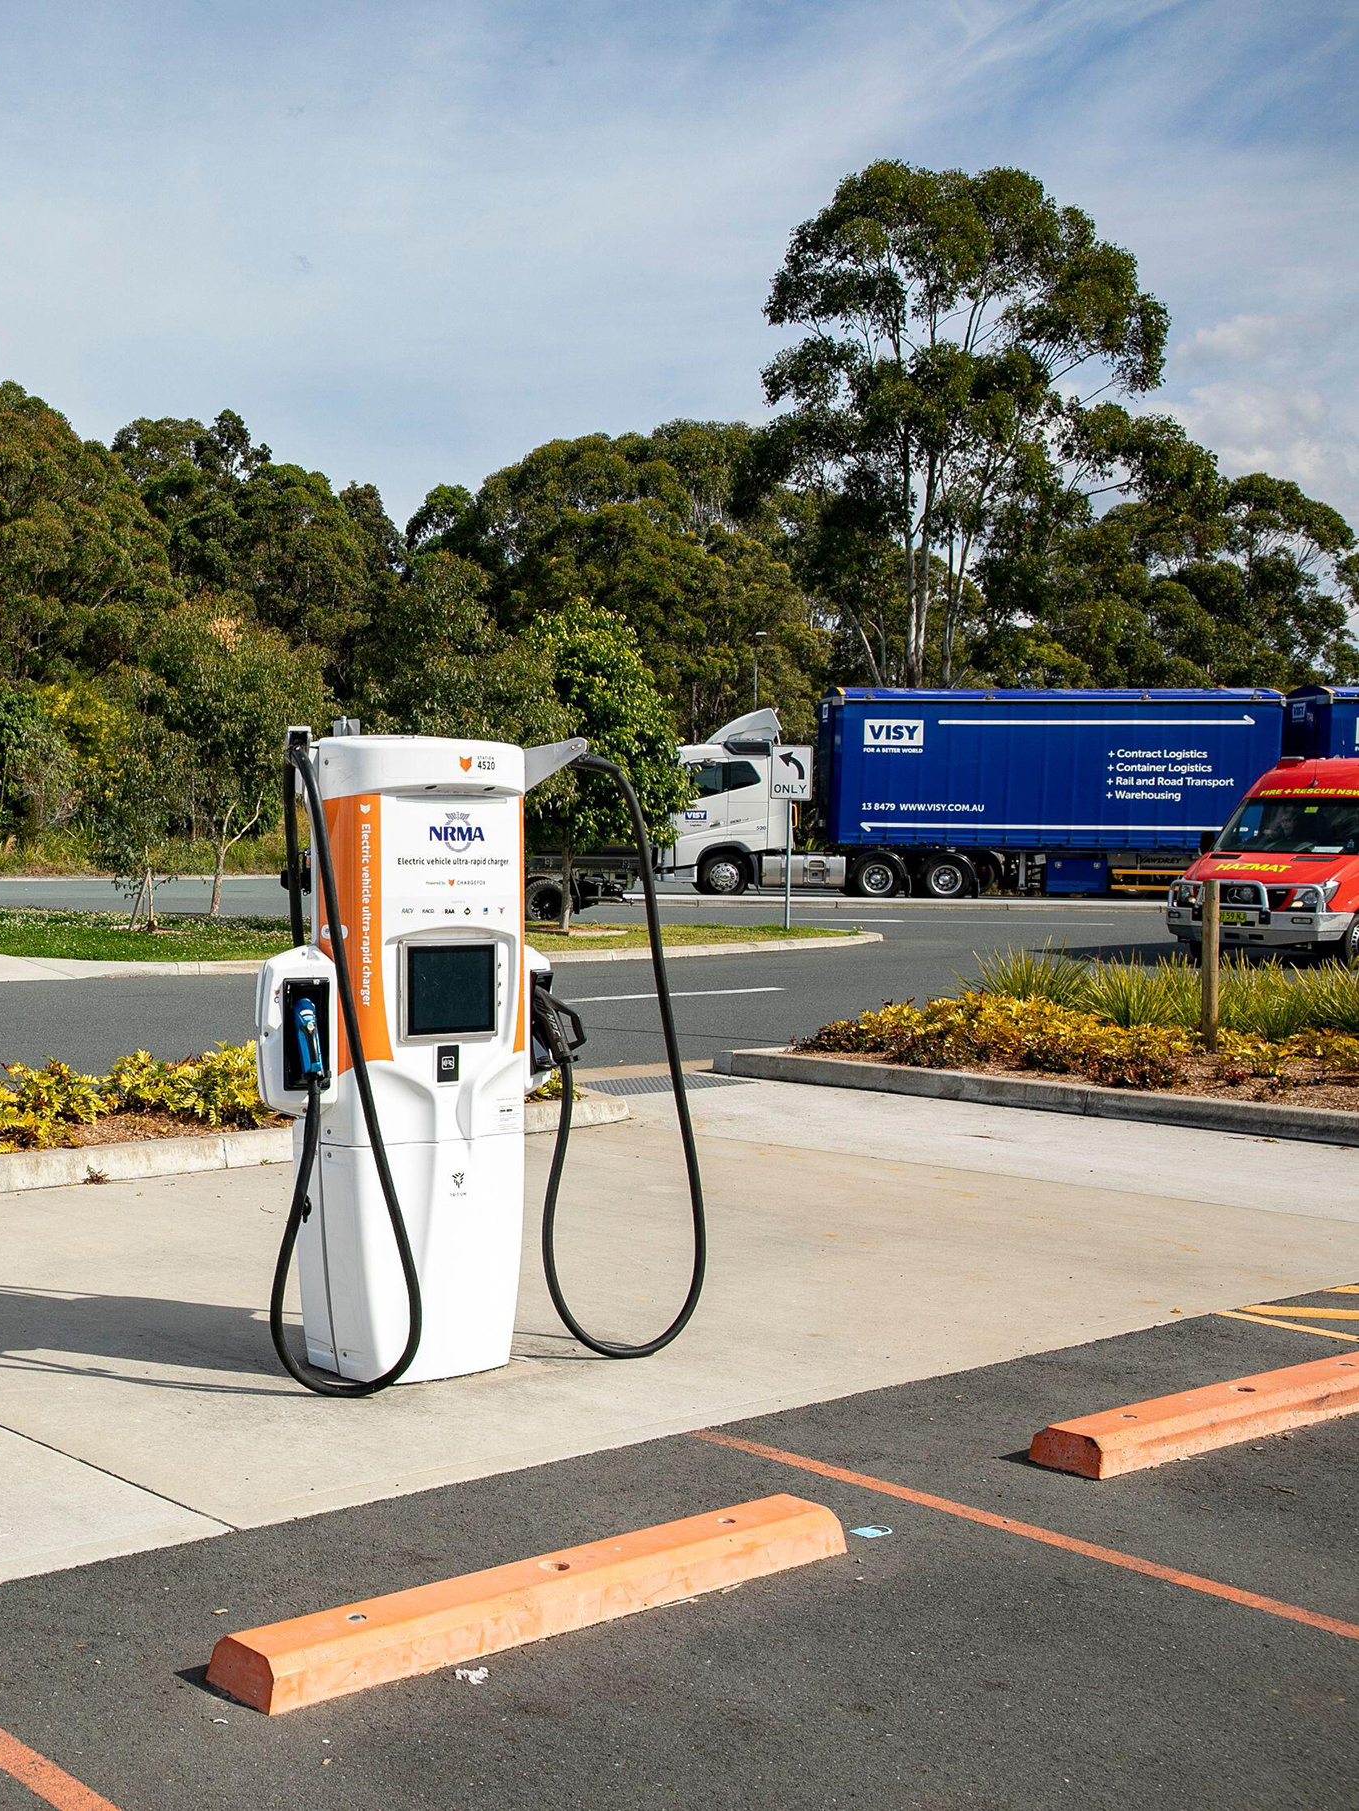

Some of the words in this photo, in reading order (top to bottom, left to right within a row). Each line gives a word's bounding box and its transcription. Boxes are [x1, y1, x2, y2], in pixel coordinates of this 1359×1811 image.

[869, 725, 919, 740] VISY
[1117, 749, 1162, 758] Contract
[1163, 750, 1208, 760] Logistics
[477, 761, 496, 770] 4520
[1116, 763, 1167, 772] Container
[1168, 763, 1213, 774] Logistics
[1115, 777, 1134, 786] Rail
[1136, 777, 1155, 786] and
[1157, 777, 1183, 786] Road
[1185, 777, 1235, 788] Transport
[774, 784, 807, 794] ONLY
[1115, 790, 1181, 801] Warehousing
[862, 803, 872, 811] 13
[874, 803, 896, 811] 8479
[899, 803, 985, 812] WWW.VISY.COM.AU
[686, 811, 706, 819] VISY
[429, 826, 485, 842] NRMA
[361, 823, 371, 864] Electric
[397, 857, 424, 866] Electric
[426, 857, 452, 866] vehicle
[453, 857, 487, 867] ultra-rapid
[488, 858, 509, 867] charger
[1215, 863, 1292, 873] HAZMAT
[361, 866, 372, 903] vehicle
[361, 906, 373, 964] ultra-rapid
[360, 966, 373, 1007] charger
